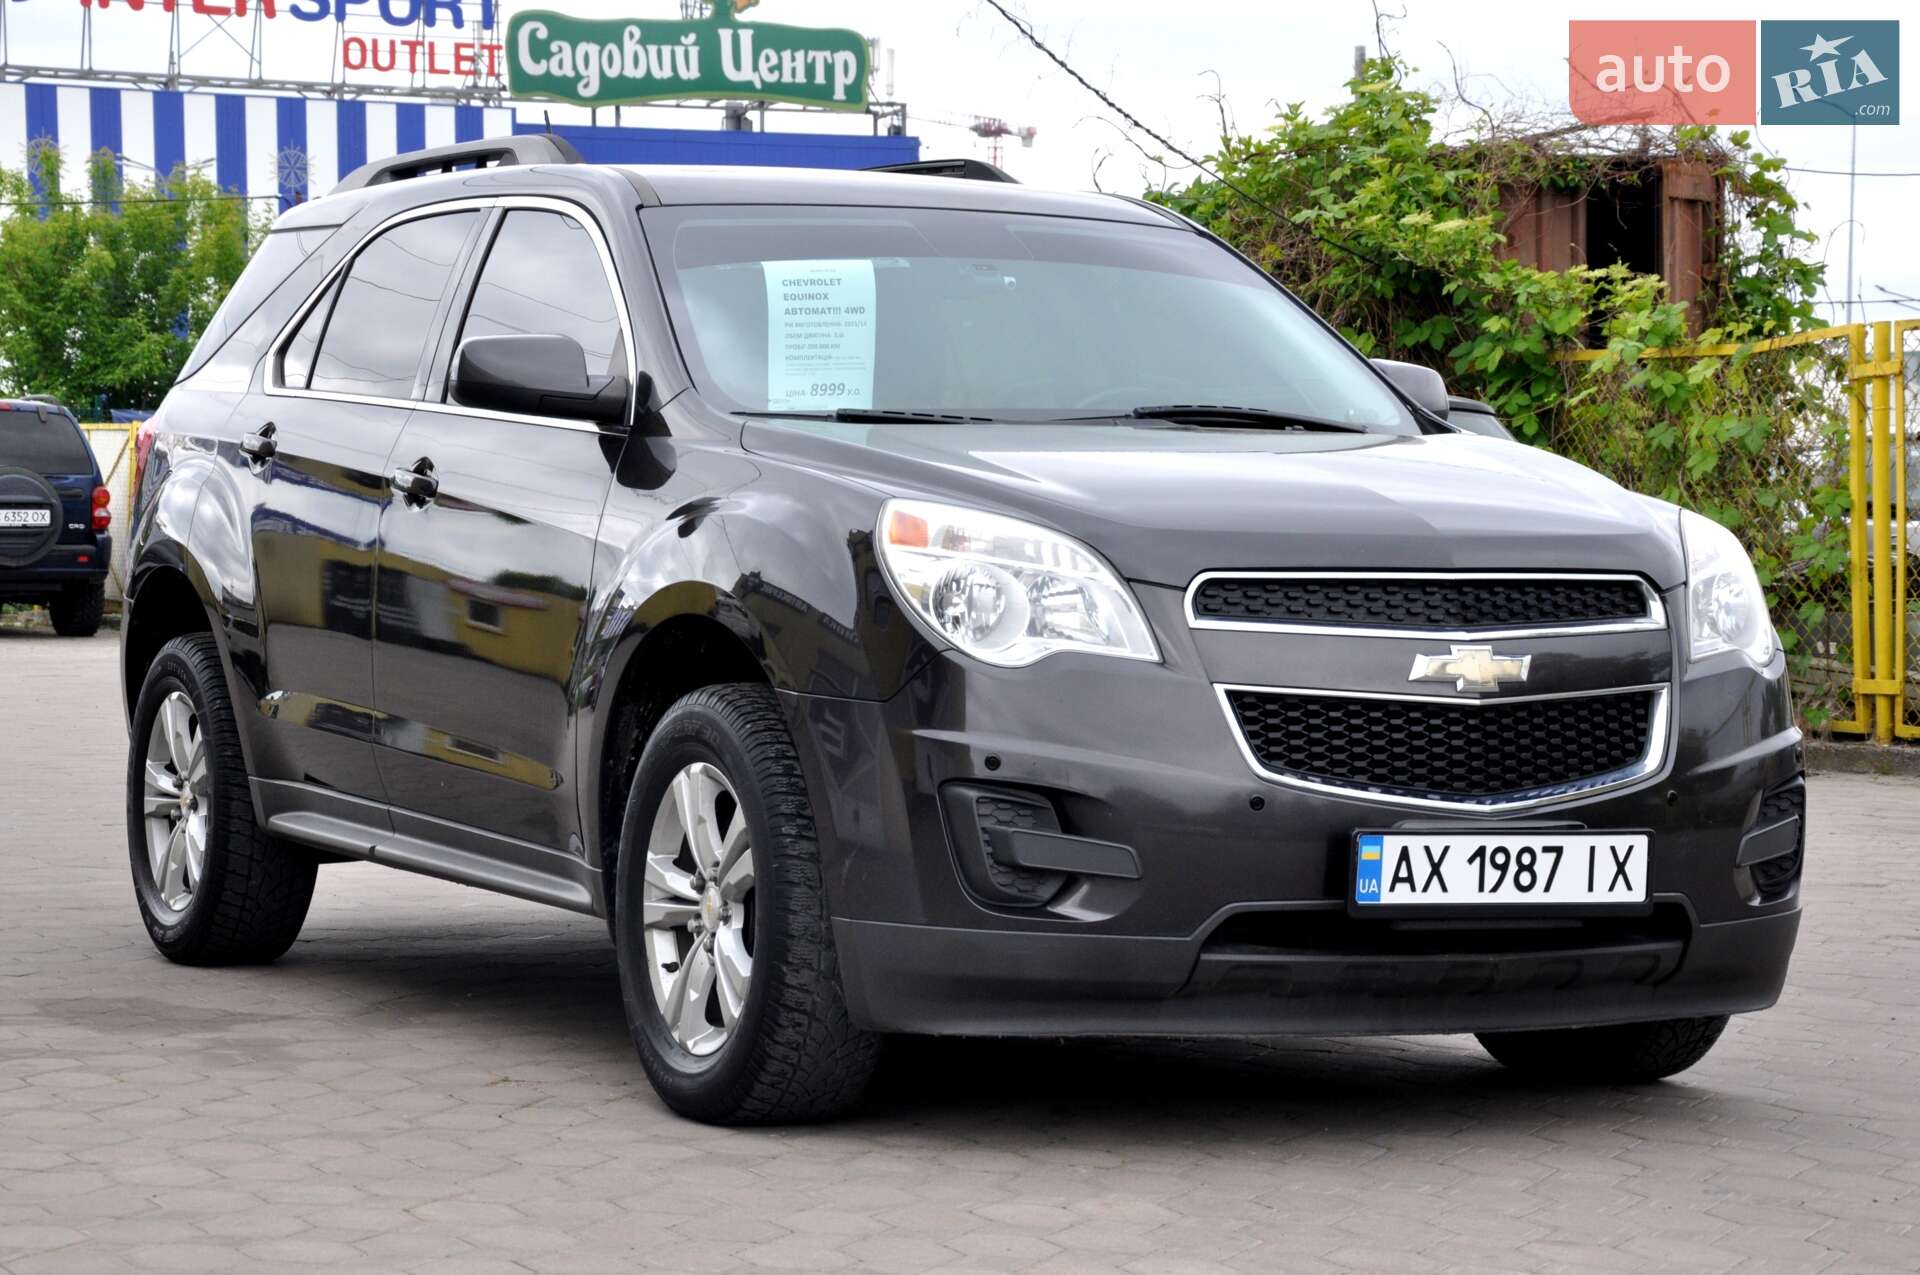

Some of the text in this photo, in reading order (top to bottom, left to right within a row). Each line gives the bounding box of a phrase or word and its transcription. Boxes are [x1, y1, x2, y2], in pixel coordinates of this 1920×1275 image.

[343, 37, 503, 77] OUTLET
[516, 20, 857, 101] Садовий Центр
[781, 278, 842, 287] CHEVROLET
[783, 292, 830, 301] EQUINOX
[844, 306, 866, 315] 4WD
[810, 382, 846, 397] 8999
[4, 511, 30, 523] 6352
[32, 511, 48, 523] OX
[1388, 845, 1635, 894] AX 1987 IX
[1359, 879, 1379, 894] UA
